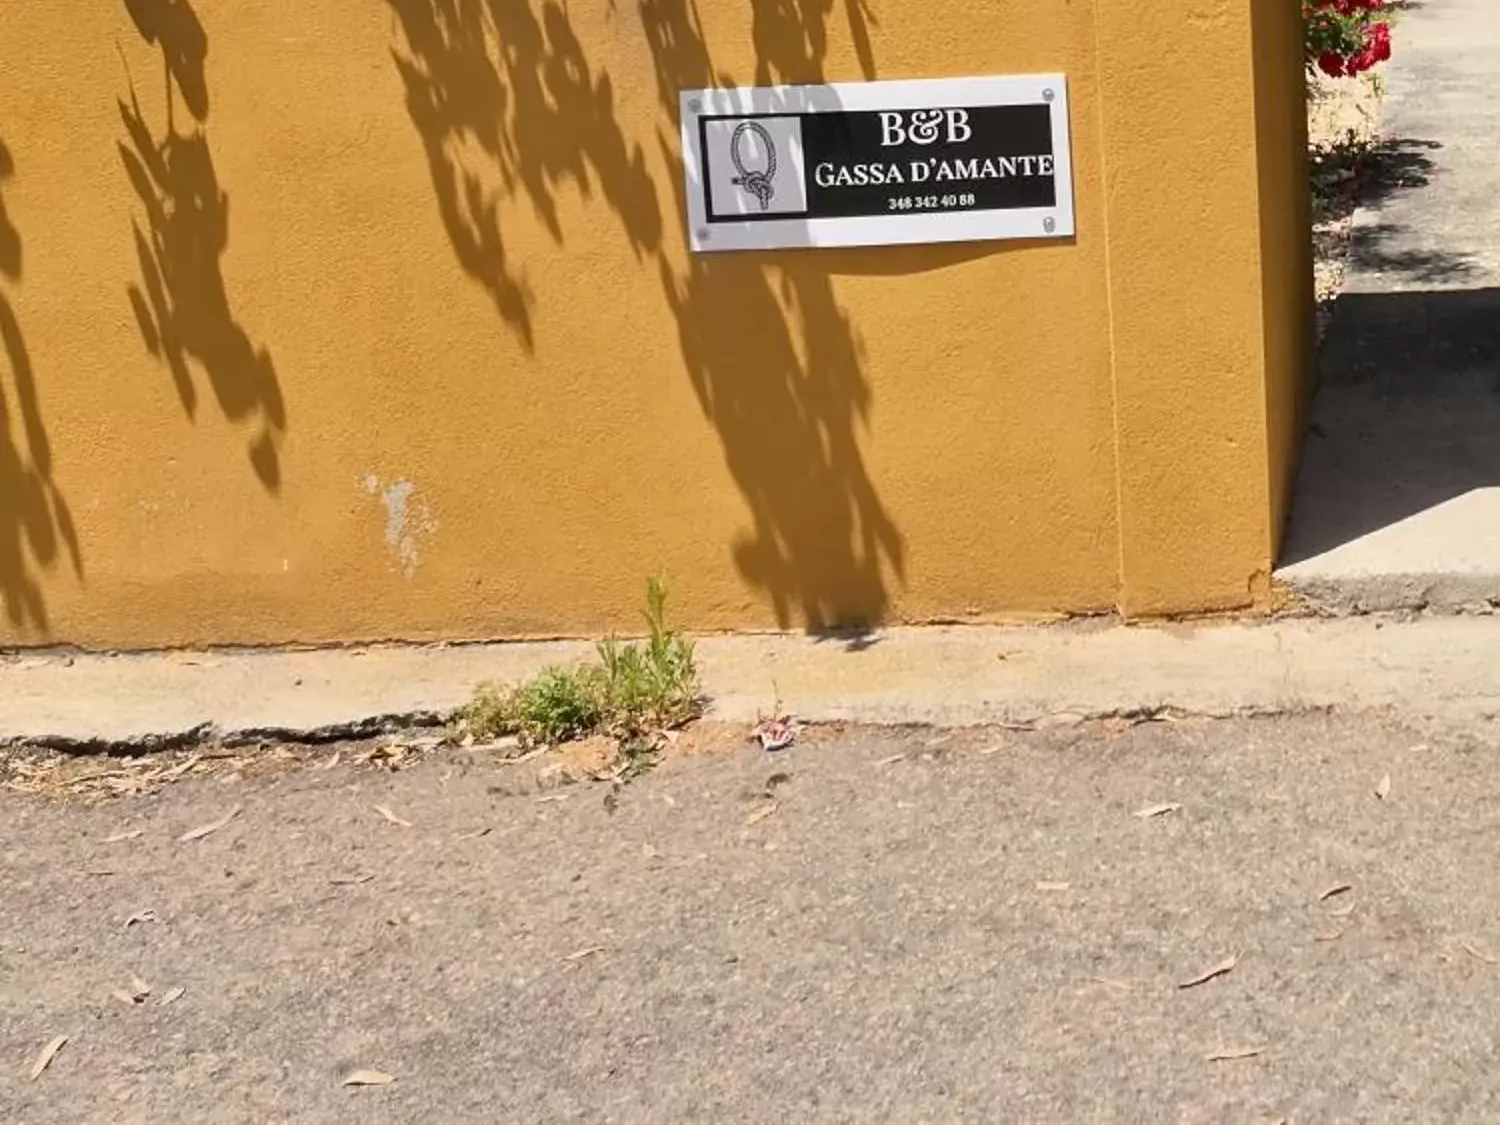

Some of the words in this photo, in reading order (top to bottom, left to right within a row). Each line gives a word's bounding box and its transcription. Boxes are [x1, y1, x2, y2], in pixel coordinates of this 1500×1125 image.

[879, 108, 972, 146] B&B
[815, 162, 905, 187] GASSA
[911, 154, 1053, 183] D'AMANTE
[915, 195, 939, 208] 342
[941, 194, 957, 207] 40
[960, 193, 975, 206] 88
